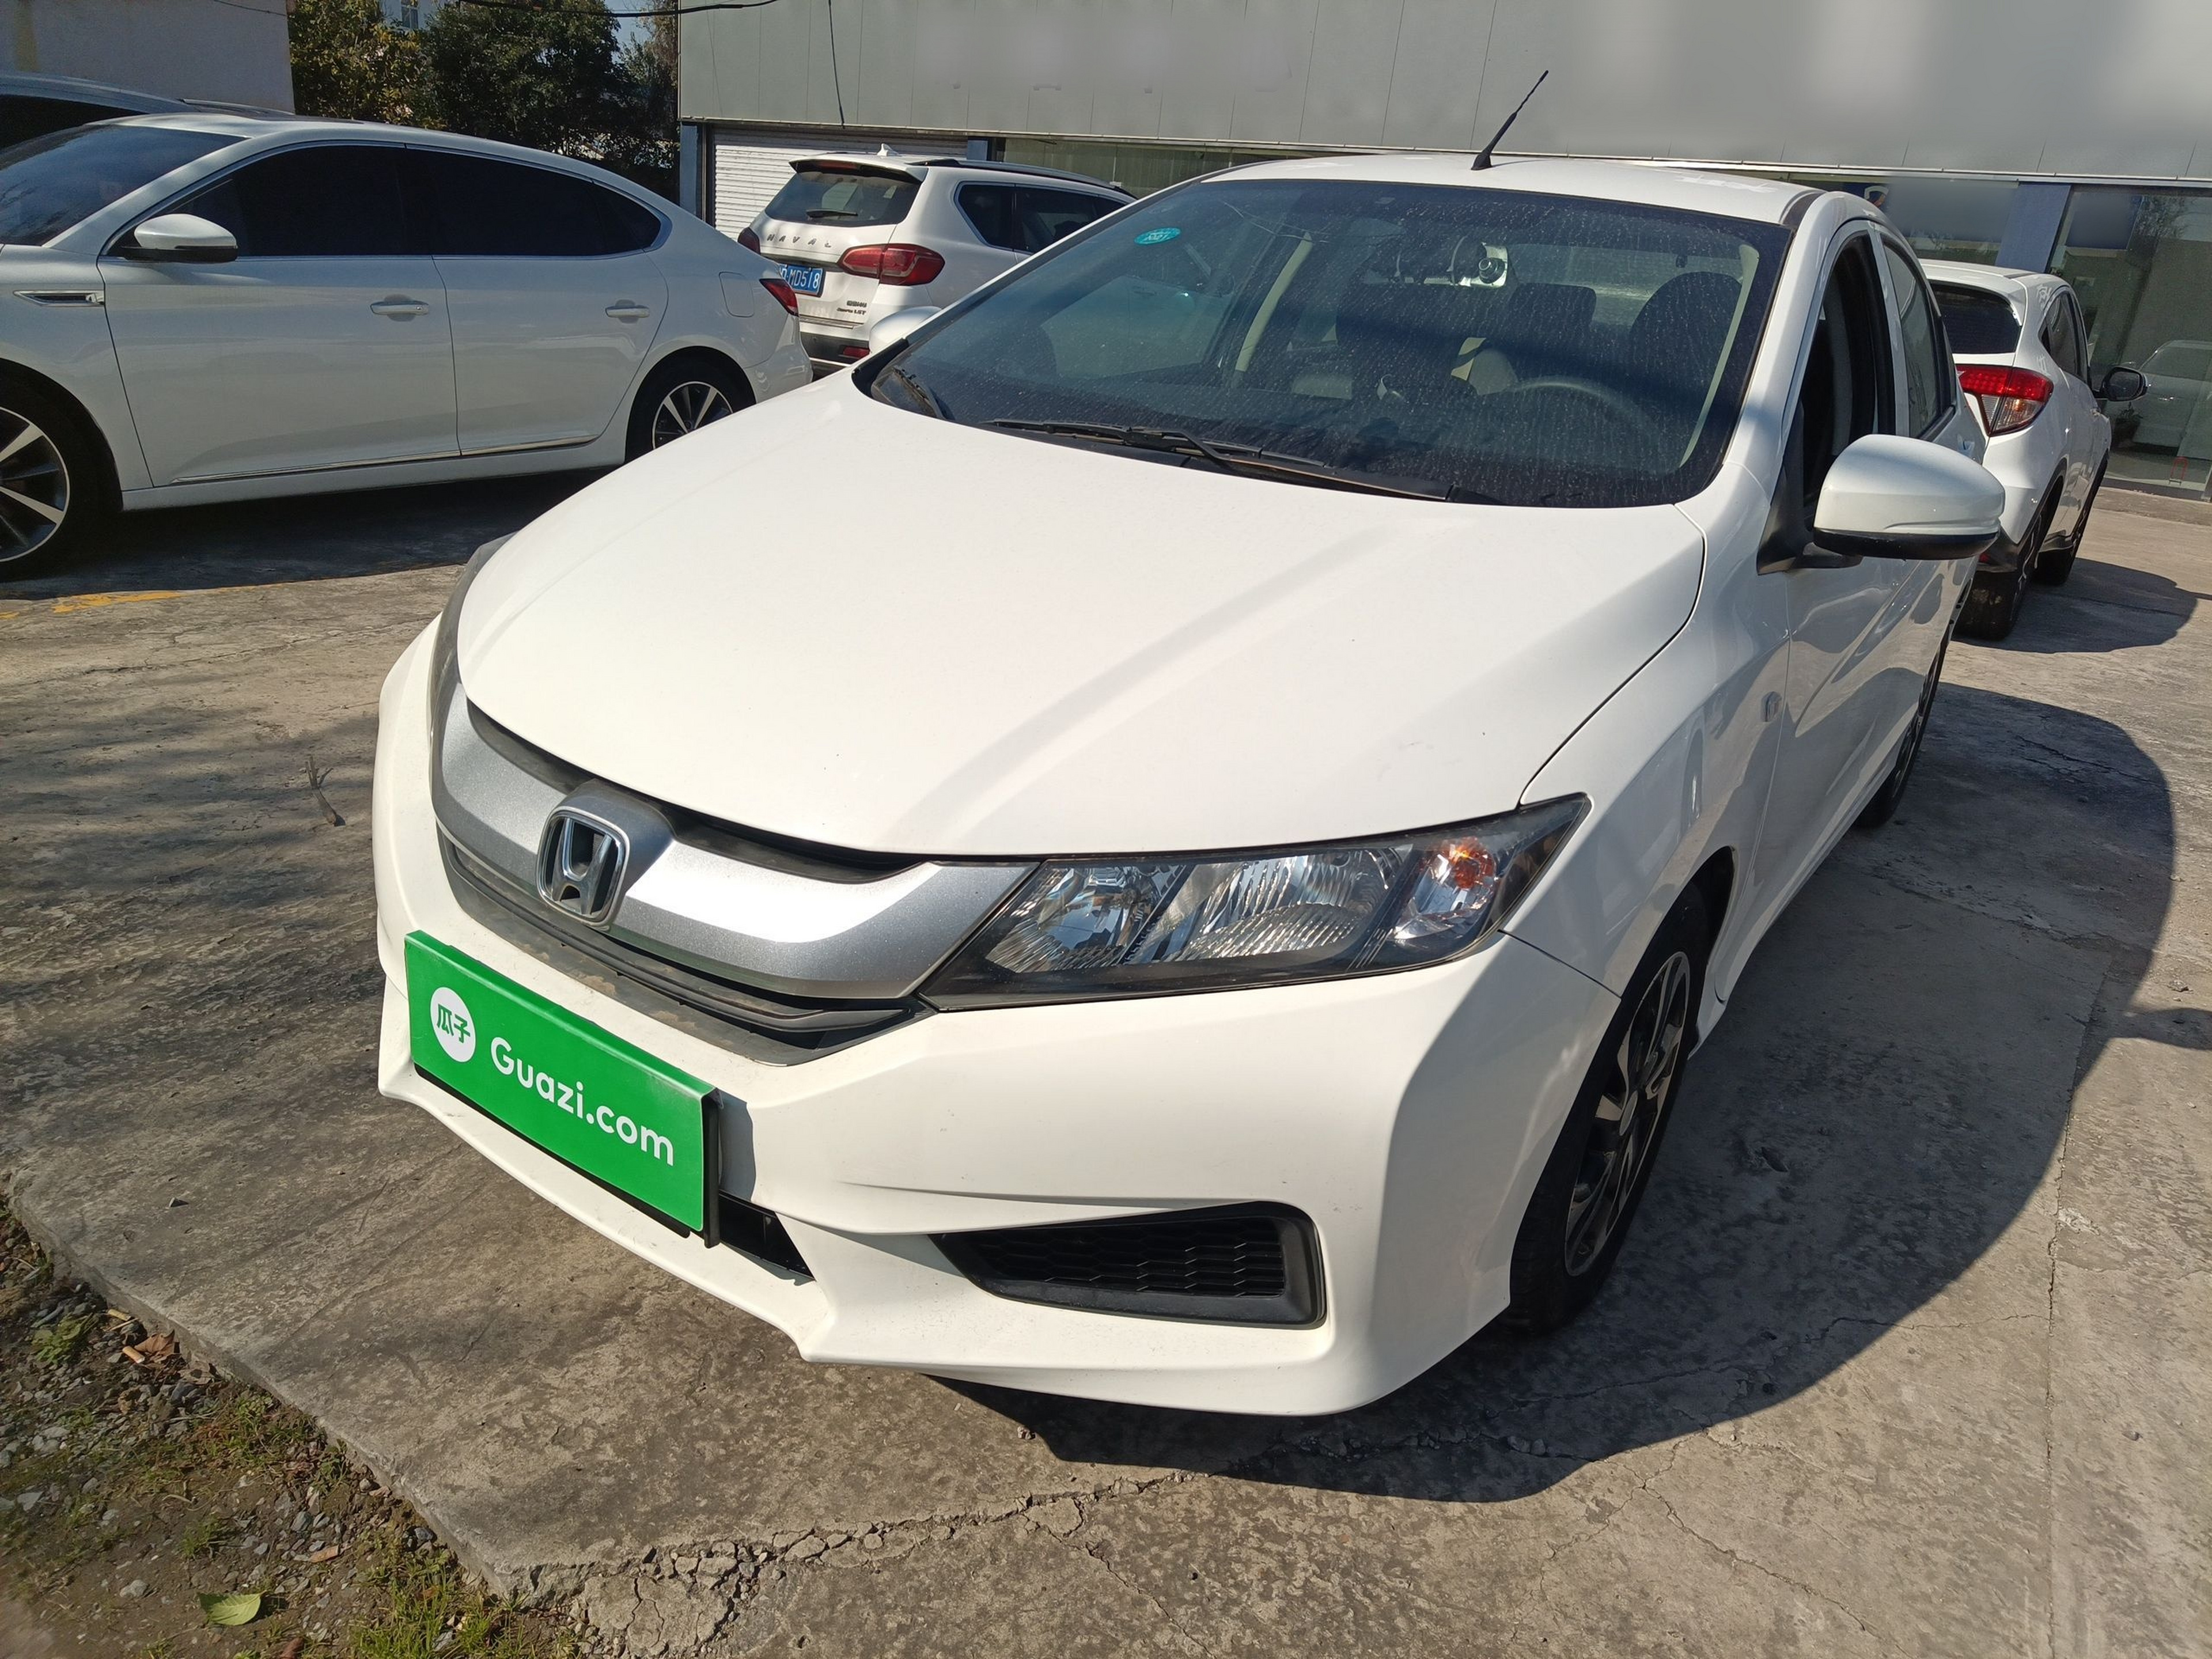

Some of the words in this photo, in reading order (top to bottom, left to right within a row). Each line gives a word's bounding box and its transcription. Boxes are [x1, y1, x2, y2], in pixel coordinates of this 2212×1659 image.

[767, 234, 832, 248] HAVAL
[437, 1003, 471, 1043] 瓜子
[491, 1037, 674, 1166] Guazi.com
